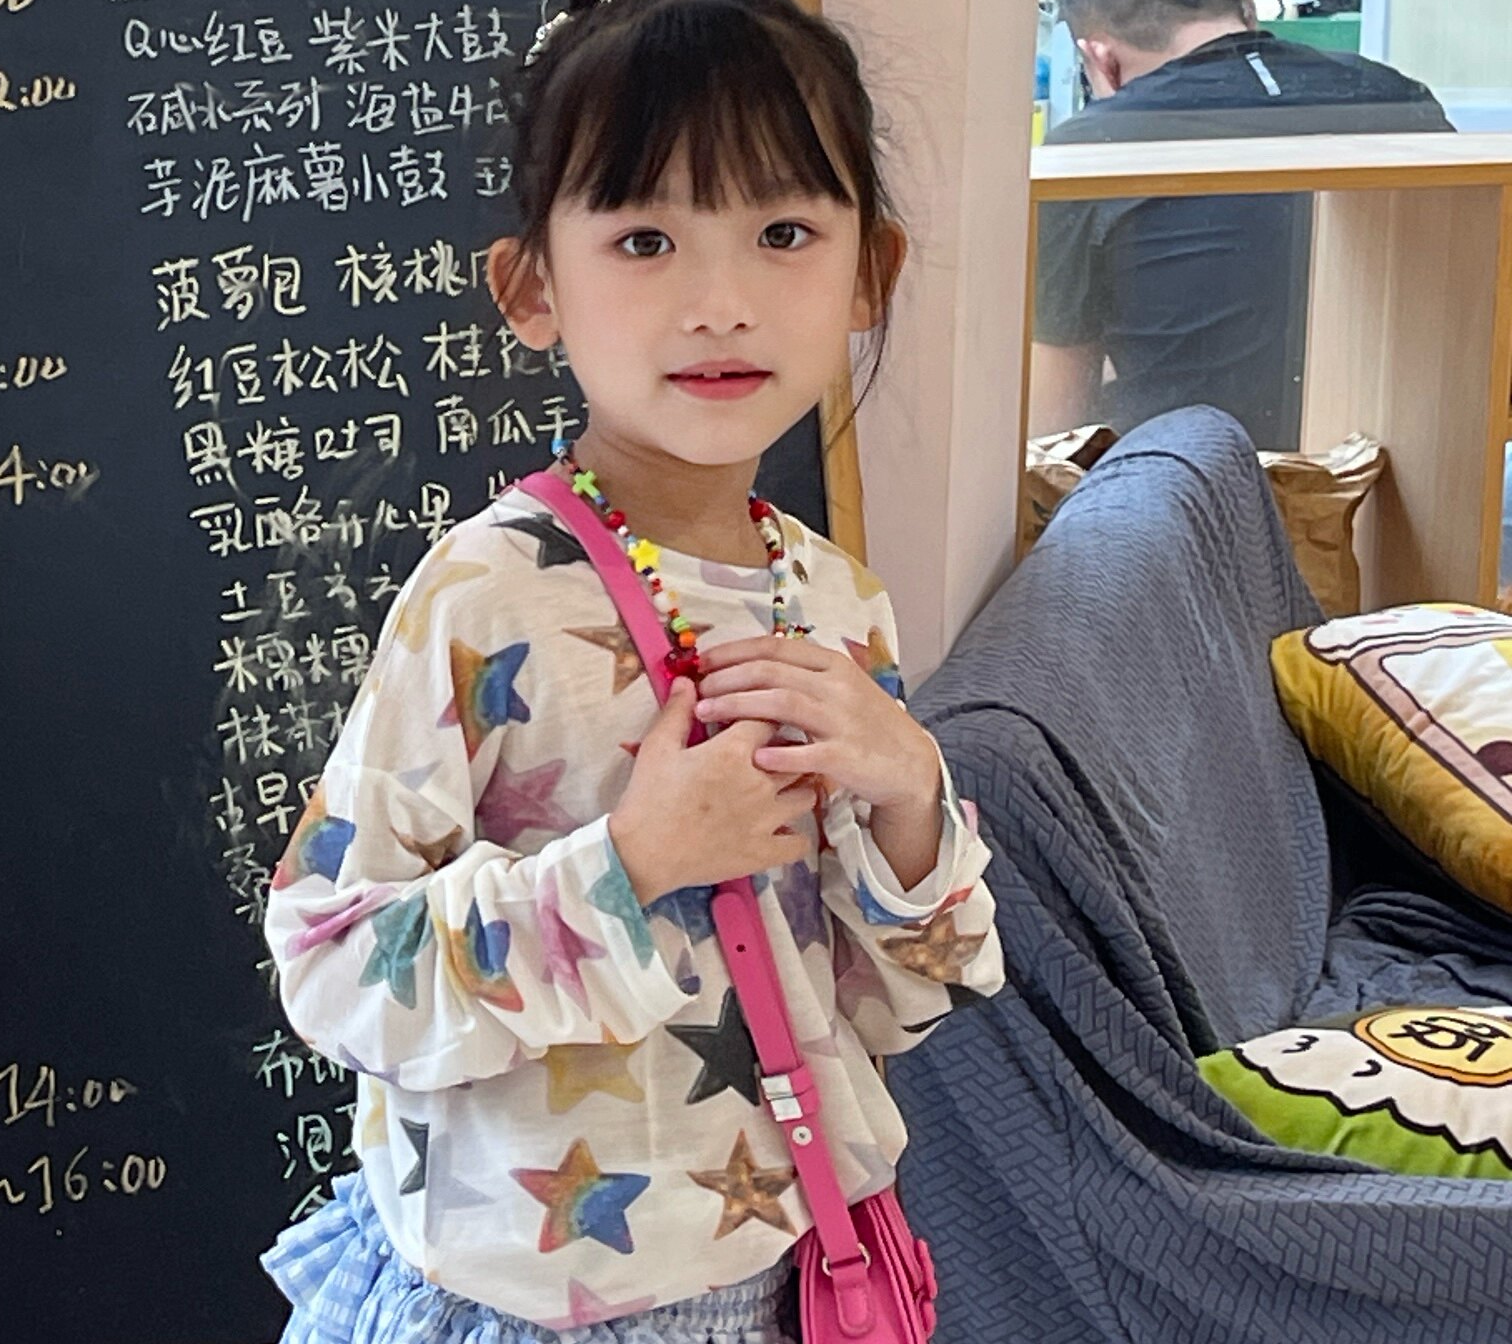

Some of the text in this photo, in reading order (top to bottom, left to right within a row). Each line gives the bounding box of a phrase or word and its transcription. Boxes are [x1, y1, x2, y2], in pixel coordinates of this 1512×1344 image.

[123, 8, 294, 67] Q心红豆
[166, 333, 410, 411] 红豆松松
[182, 394, 590, 487] 黑糖吐司 南瓜手
